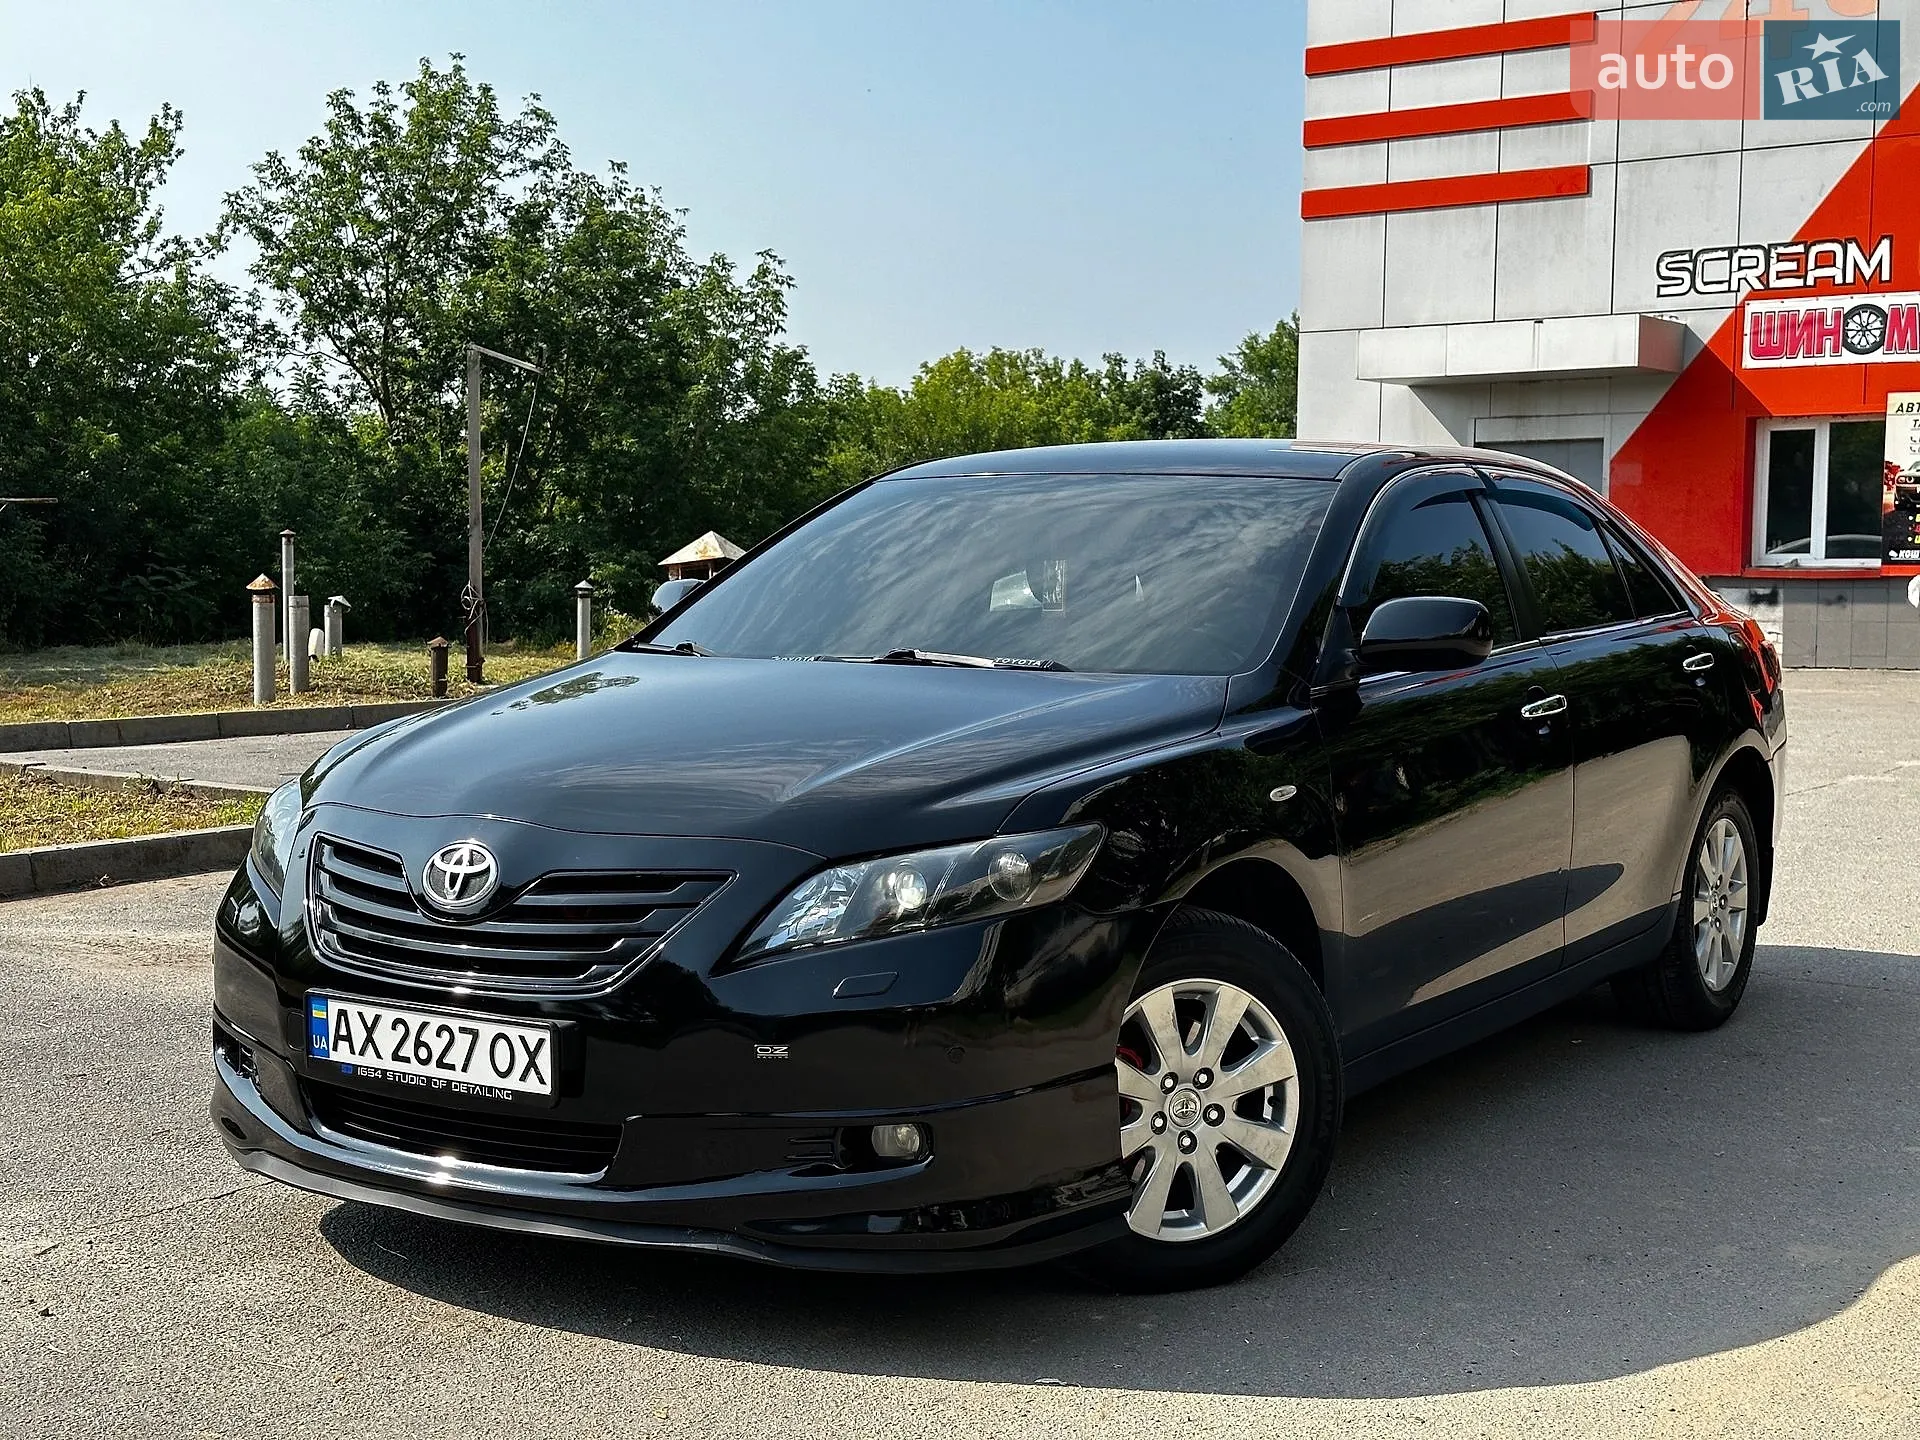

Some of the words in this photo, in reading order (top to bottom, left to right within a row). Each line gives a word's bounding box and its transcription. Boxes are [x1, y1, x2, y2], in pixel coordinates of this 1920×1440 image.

[1656, 234, 1894, 298] SCREAM
[995, 657, 1041, 667] TOYOTA
[313, 1034, 328, 1051] UA
[331, 1008, 383, 1060] AX
[391, 1017, 480, 1073] 2627
[489, 1032, 547, 1085] OX
[757, 1046, 788, 1054] OZ
[386, 1071, 427, 1086] STUDIO
[431, 1078, 447, 1089] OF
[452, 1082, 512, 1101] DETAILING
